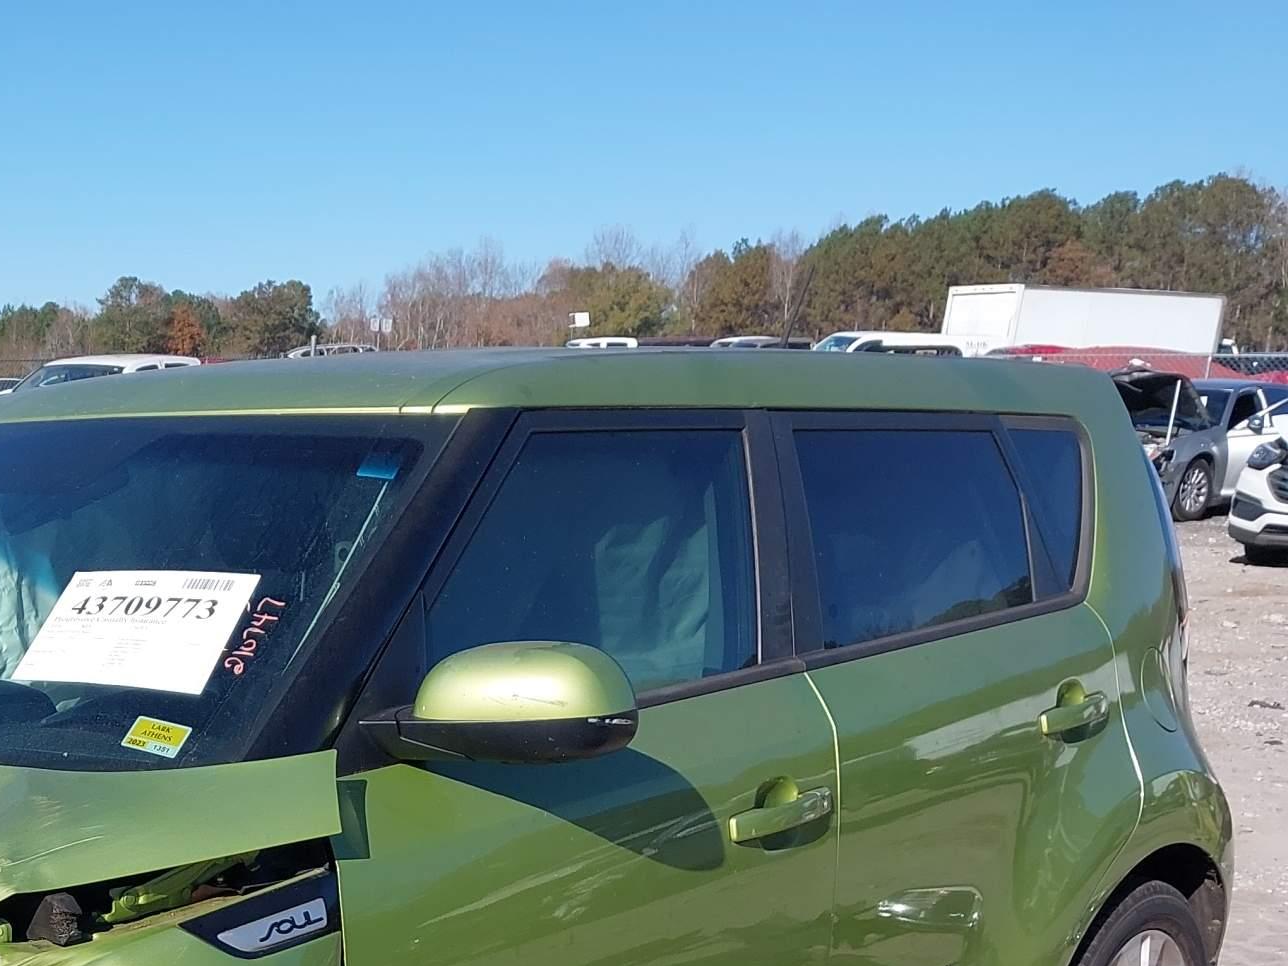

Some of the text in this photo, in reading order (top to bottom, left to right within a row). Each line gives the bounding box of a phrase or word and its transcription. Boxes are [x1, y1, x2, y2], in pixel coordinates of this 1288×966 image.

[72, 595, 218, 619] 43709773
[127, 738, 146, 747] 2023
[141, 730, 173, 742] ATHENS
[259, 911, 324, 942] SOUL
